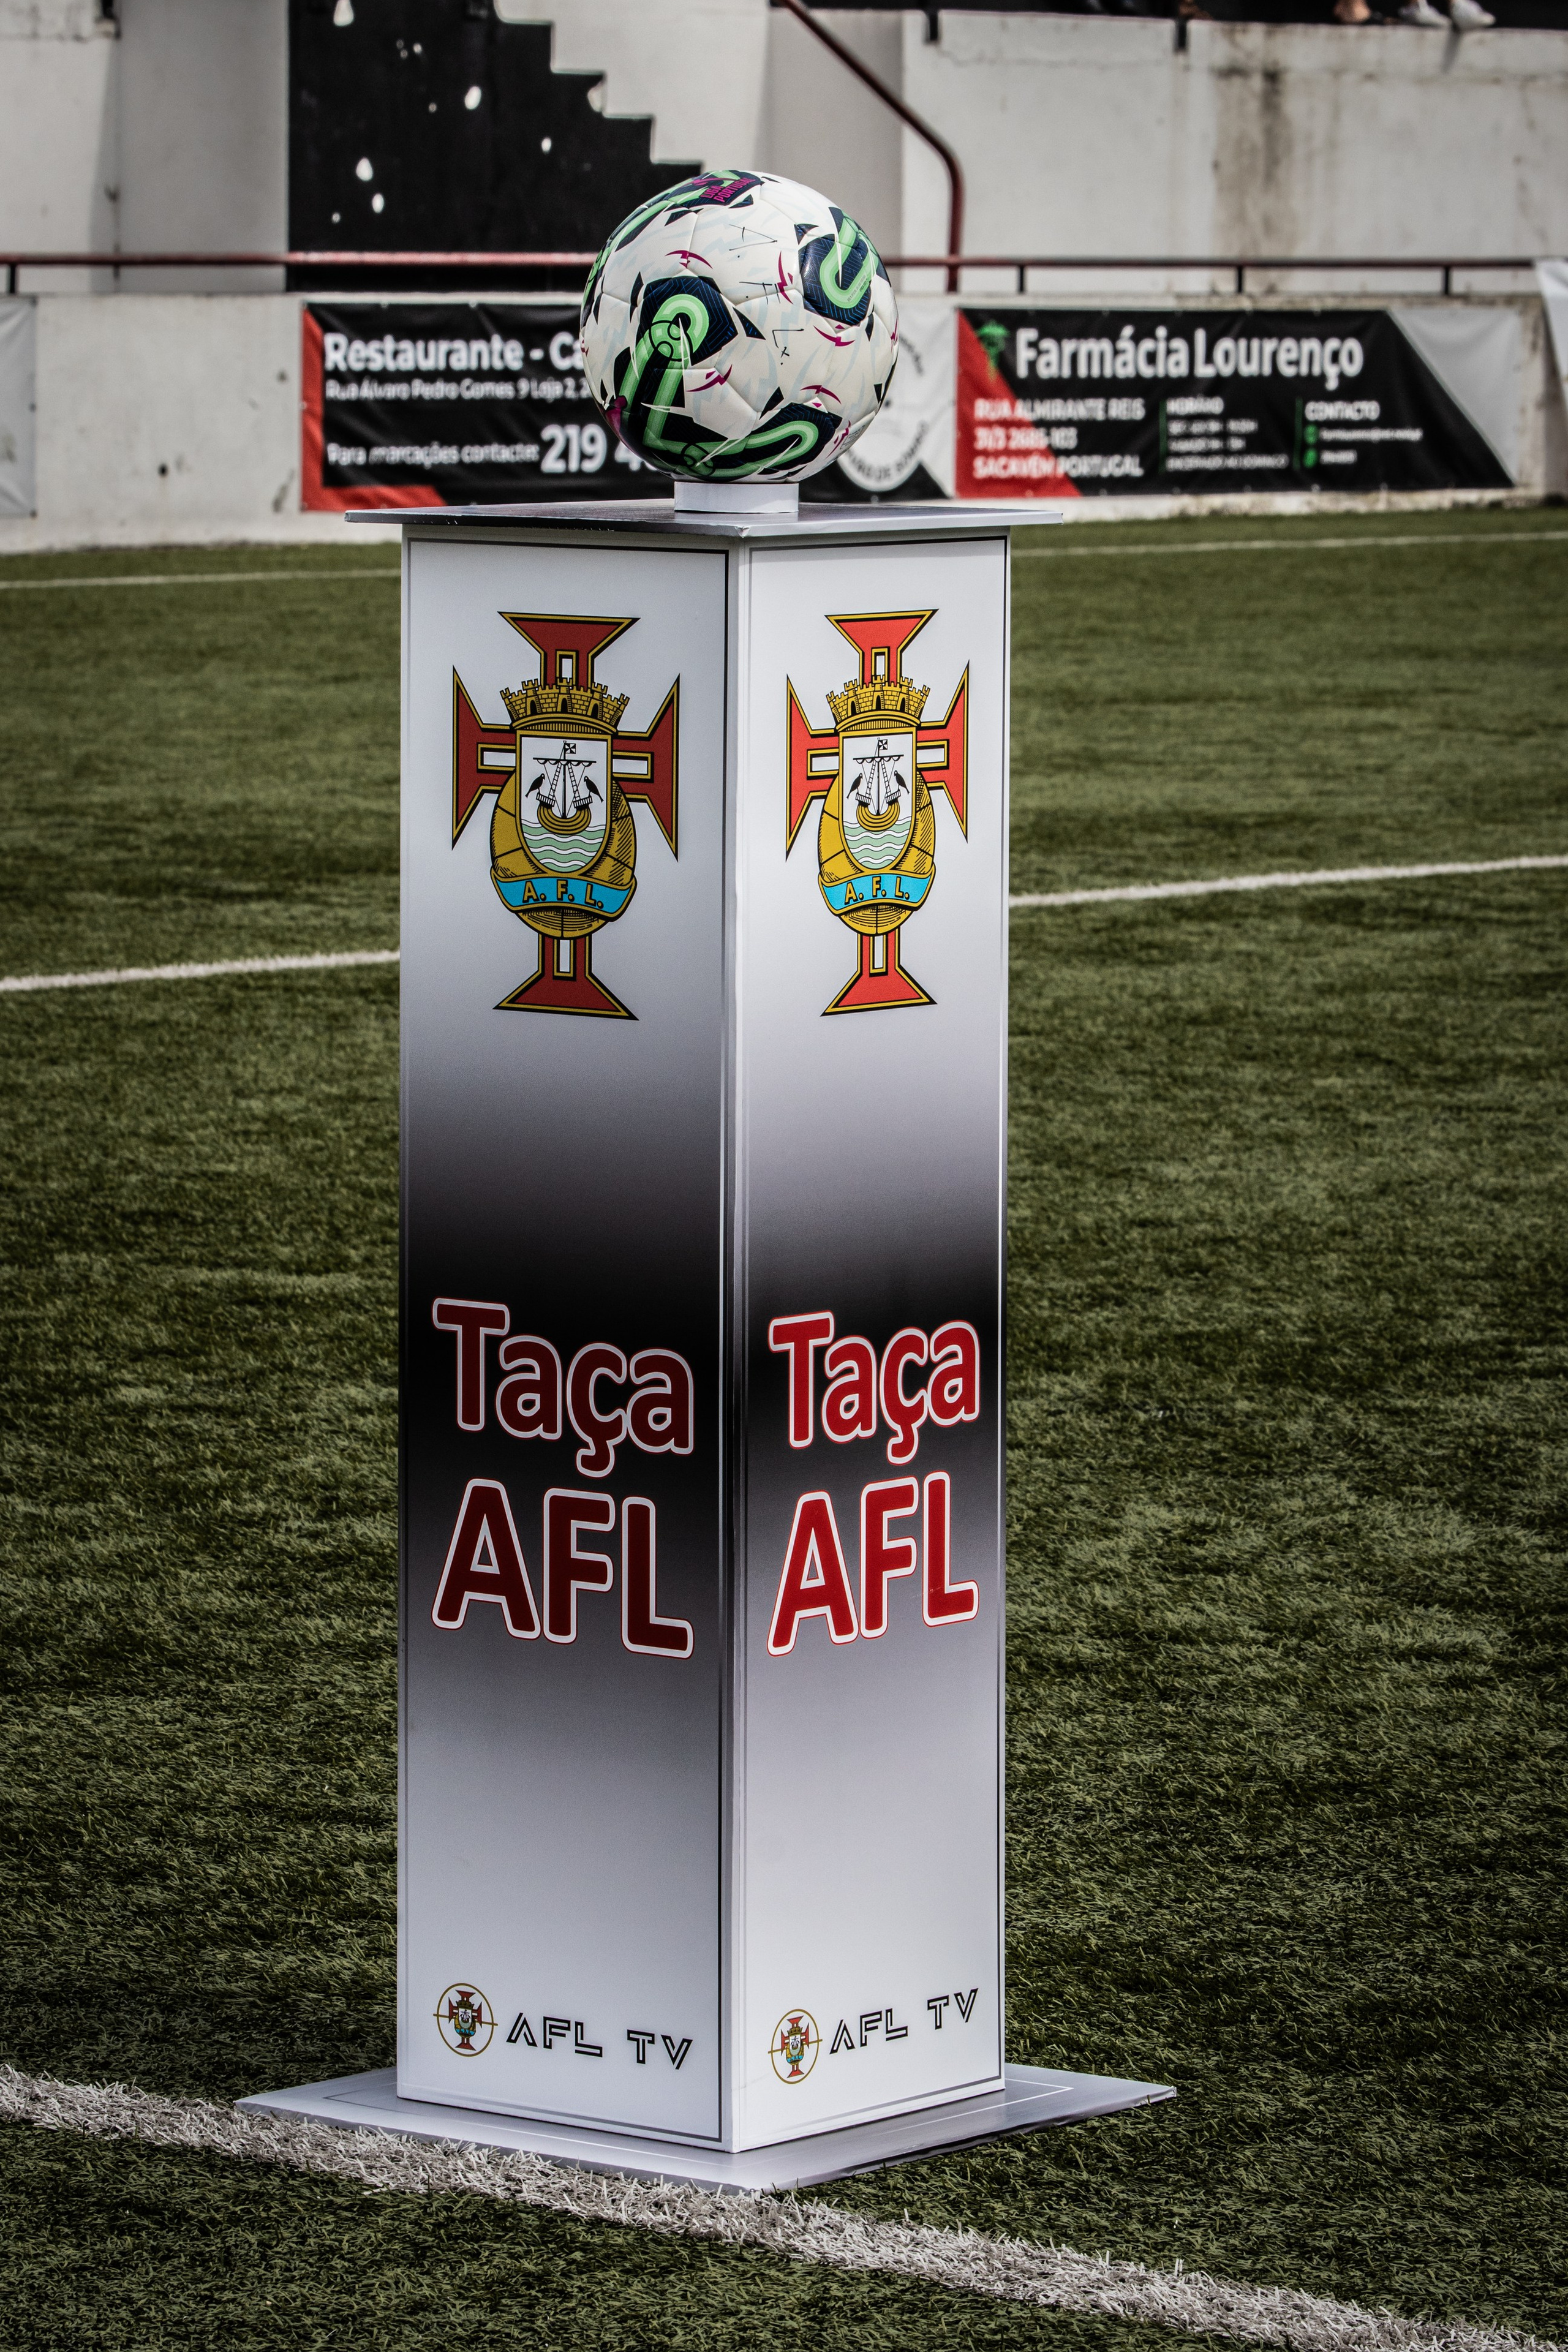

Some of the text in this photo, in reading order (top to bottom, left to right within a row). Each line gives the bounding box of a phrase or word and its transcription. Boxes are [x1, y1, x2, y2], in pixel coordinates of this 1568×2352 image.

[700, 185, 724, 199] LIGA
[713, 177, 756, 203] PORTUGAL
[325, 333, 523, 371] Restaurante
[1016, 325, 1363, 391] Farmácia Lourenço
[326, 380, 358, 399] Rua
[411, 379, 458, 399] Pedro
[460, 379, 515, 399] Gomes
[518, 379, 529, 398] 9
[530, 379, 564, 402] Loja
[974, 397, 1146, 421] RUA ALMIRANTE REIS
[327, 443, 366, 466] Para
[369, 442, 459, 468] marcações
[541, 424, 606, 473] 219
[973, 454, 1145, 479] SACAVÉM PORTUGAL
[432, 1297, 695, 1477] Taça
[768, 1311, 980, 1464] Taça
[431, 1478, 695, 1659] AFL
[767, 1471, 979, 1657] AFL
[506, 2012, 693, 2070] AFL TV
[829, 1987, 979, 2055] AFL TV
